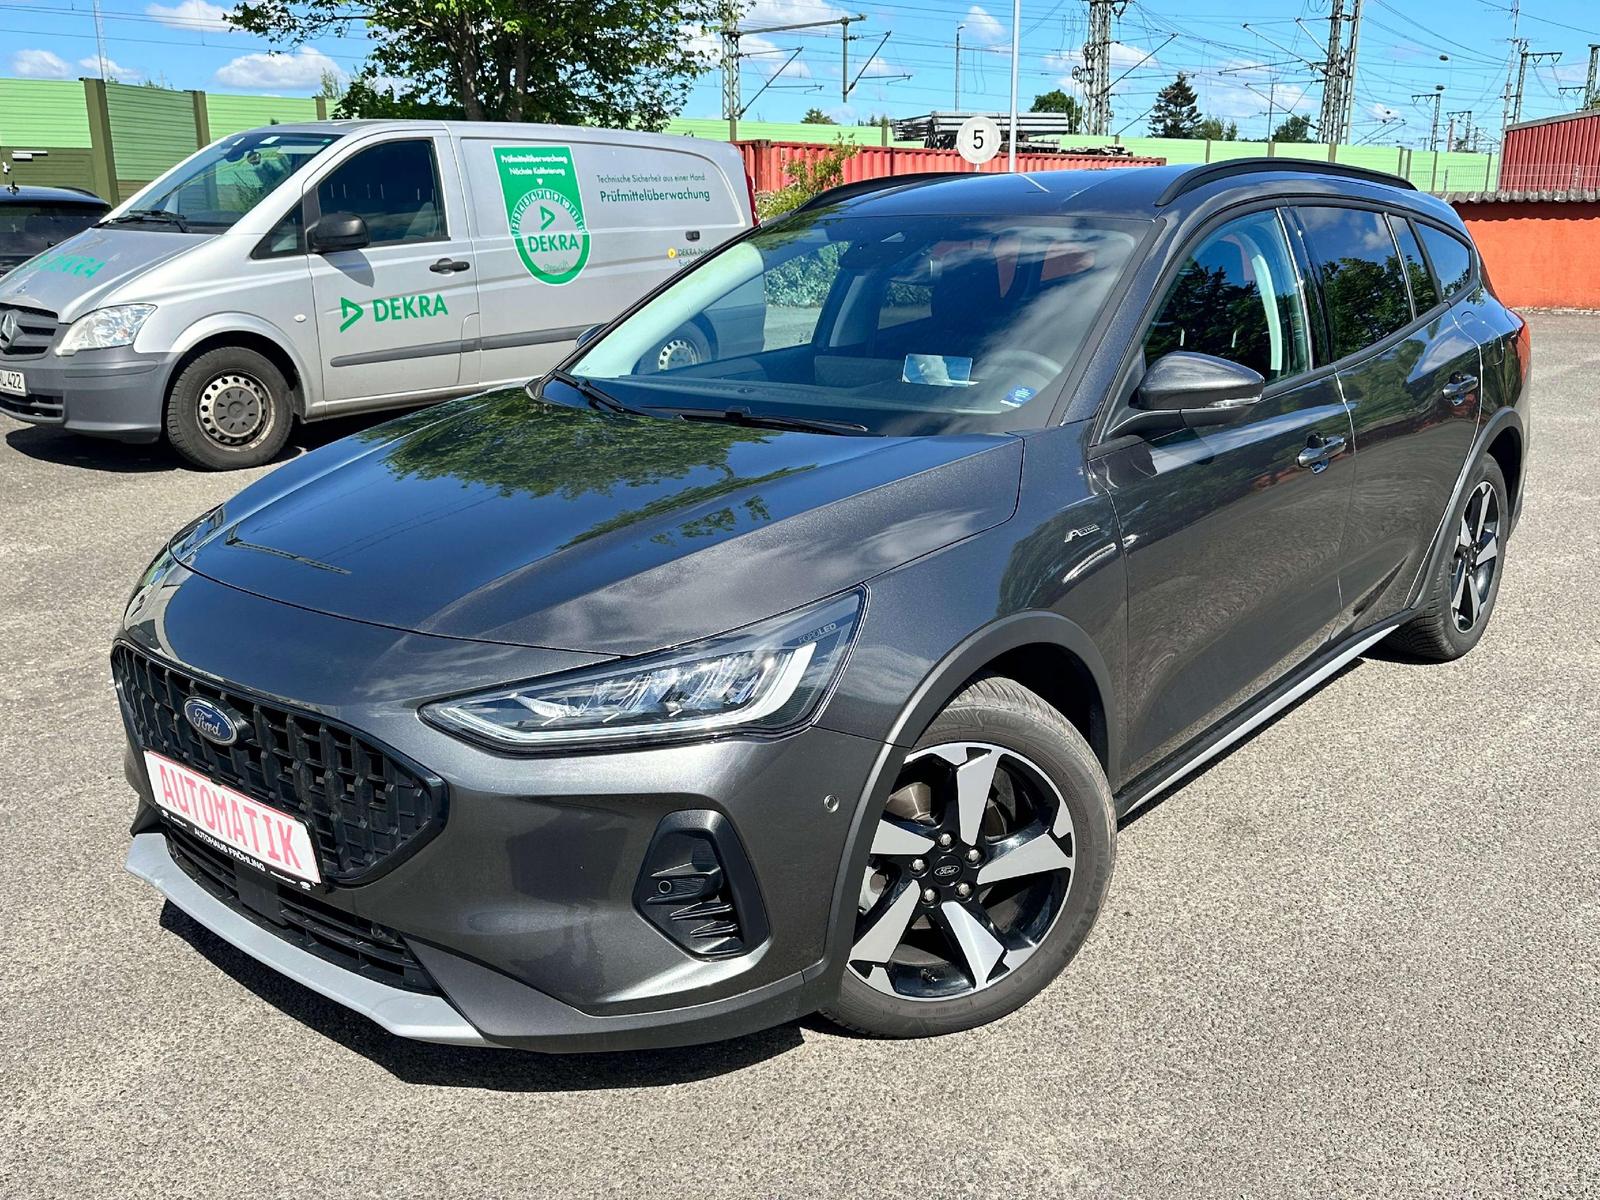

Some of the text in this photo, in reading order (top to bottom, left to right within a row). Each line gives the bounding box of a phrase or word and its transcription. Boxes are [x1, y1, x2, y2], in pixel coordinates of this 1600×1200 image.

[973, 129, 984, 149] 5
[596, 174, 631, 184] Technische
[632, 173, 661, 182] Sicherheit
[675, 174, 688, 182] einer
[600, 187, 710, 202] Prüfmittelüberwachung
[528, 233, 580, 253] DEKRA
[372, 293, 449, 323] DEKRA
[8, 373, 22, 389] 422
[193, 708, 221, 737] Ford
[159, 764, 303, 870] AUTOMATIK
[194, 828, 229, 853] AUTOHAUS
